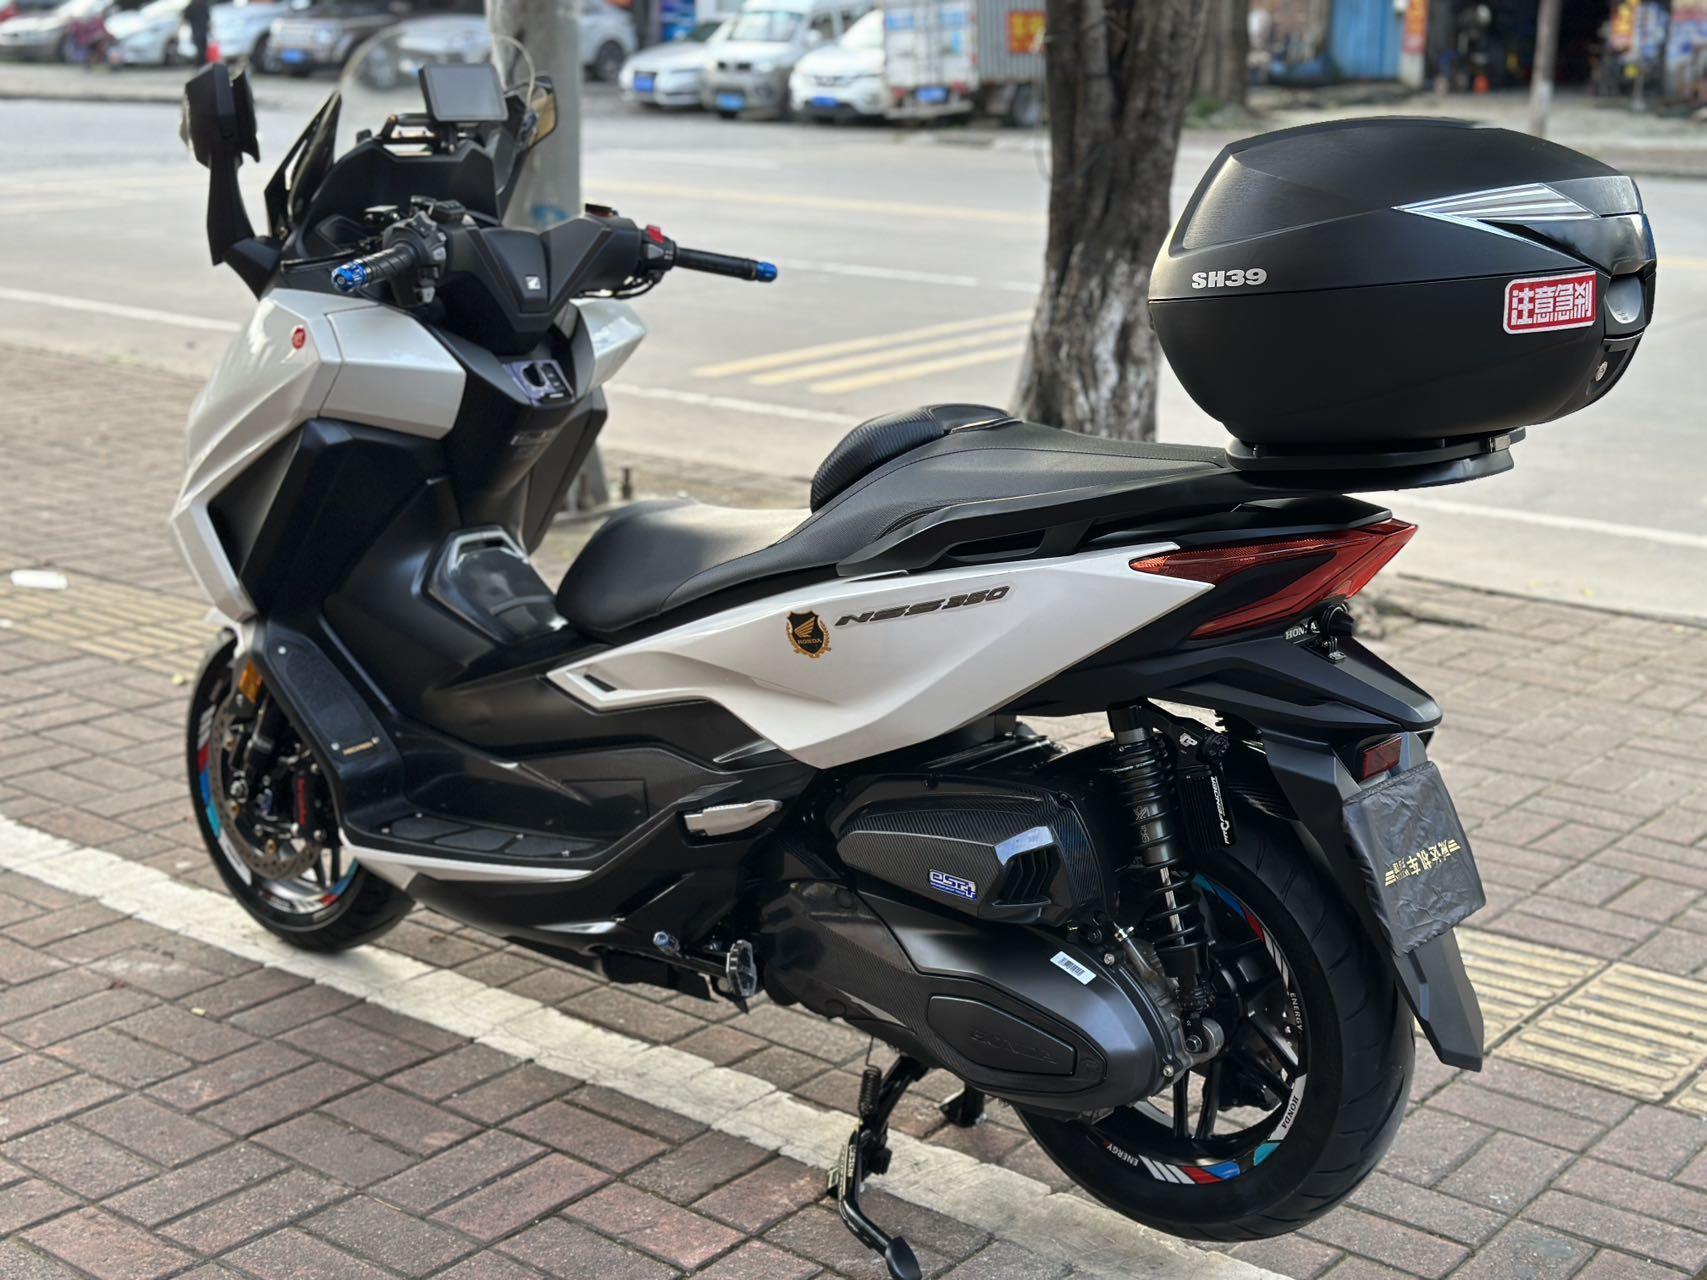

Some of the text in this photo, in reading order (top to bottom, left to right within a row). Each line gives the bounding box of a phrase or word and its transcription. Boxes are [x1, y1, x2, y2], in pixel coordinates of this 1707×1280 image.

[1191, 267, 1268, 289] SH39
[1510, 280, 1593, 326] 注意急刹
[1289, 992, 1304, 1032] ENERGY
[1281, 1095, 1299, 1129] HONDA
[1106, 1143, 1139, 1167] ENERGY
